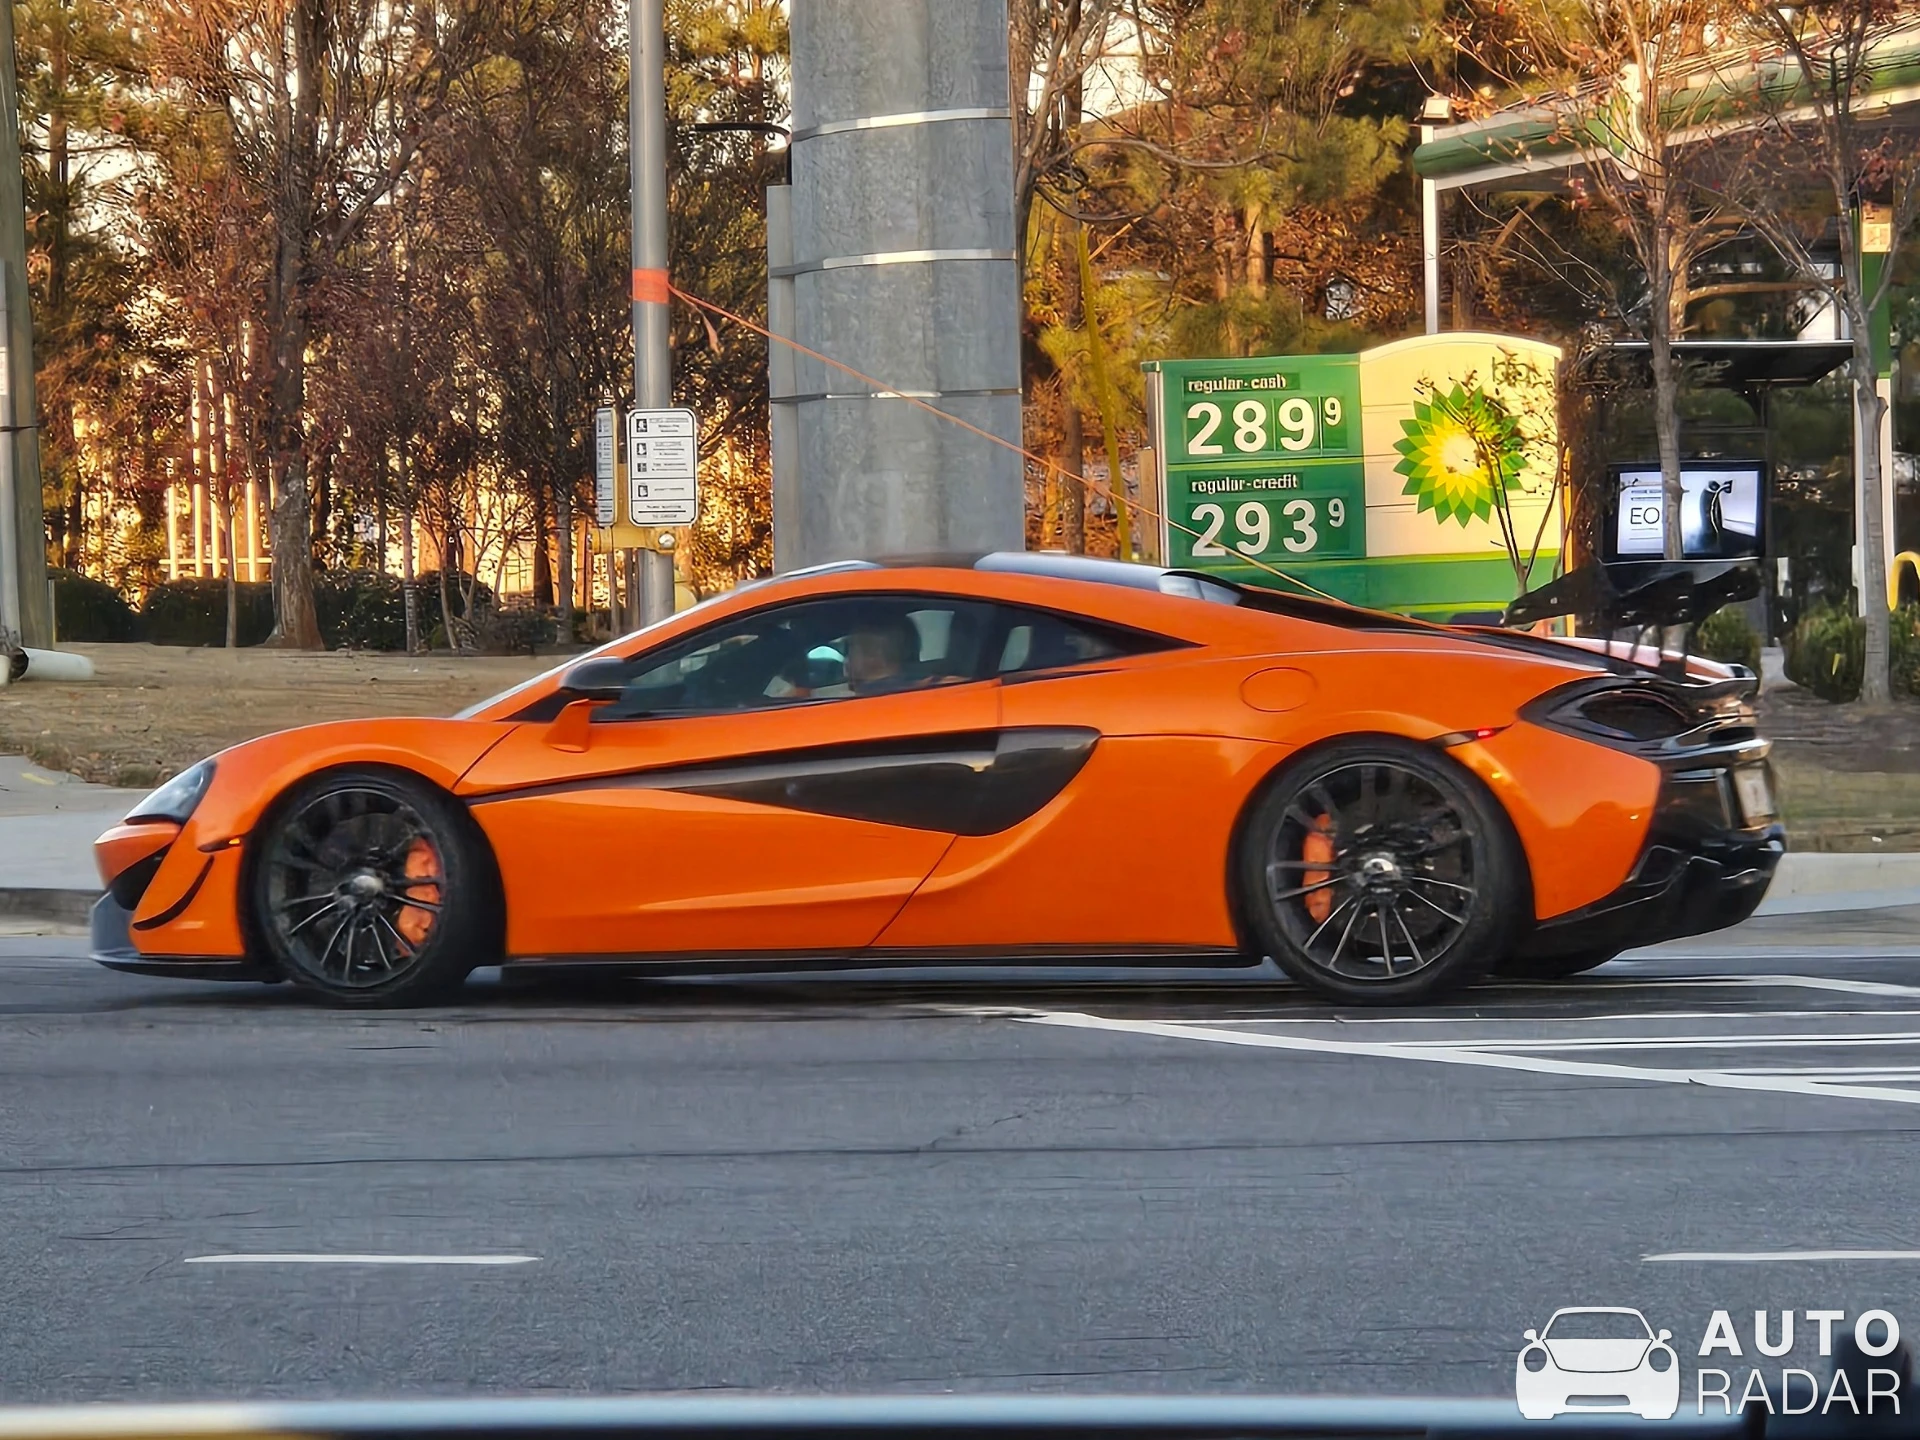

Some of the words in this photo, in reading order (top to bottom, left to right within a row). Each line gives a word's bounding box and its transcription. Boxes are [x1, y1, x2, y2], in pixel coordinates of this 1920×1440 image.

[1187, 397, 1315, 455] 289
[1324, 397, 1342, 426] 9
[1191, 499, 1318, 557] 293
[1328, 498, 1345, 528] 9
